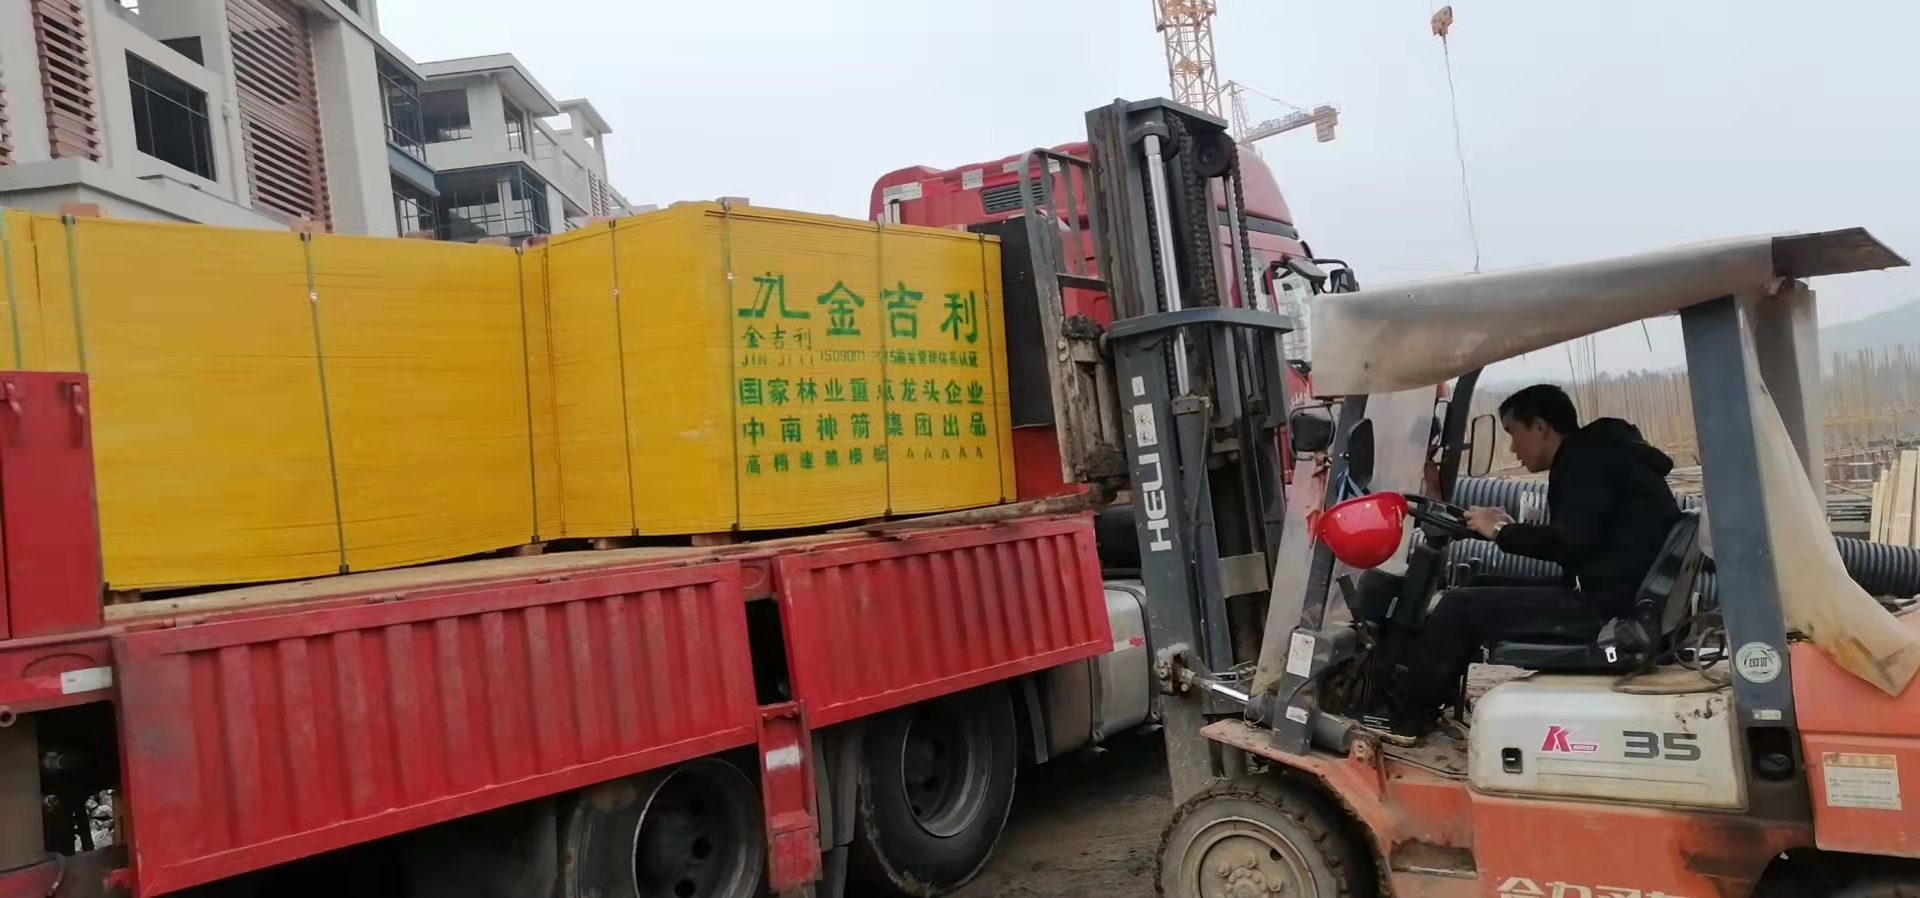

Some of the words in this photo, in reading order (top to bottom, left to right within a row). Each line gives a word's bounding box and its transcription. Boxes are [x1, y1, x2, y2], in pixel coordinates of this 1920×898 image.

[817, 280, 978, 343] 金吉利
[742, 323, 812, 350] 金吉利
[740, 377, 985, 405] 国家林业重点龙头企业
[743, 412, 986, 445] 中南神箭集团出品
[1138, 453, 1172, 551] HELI
[1622, 730, 1702, 761] 35
